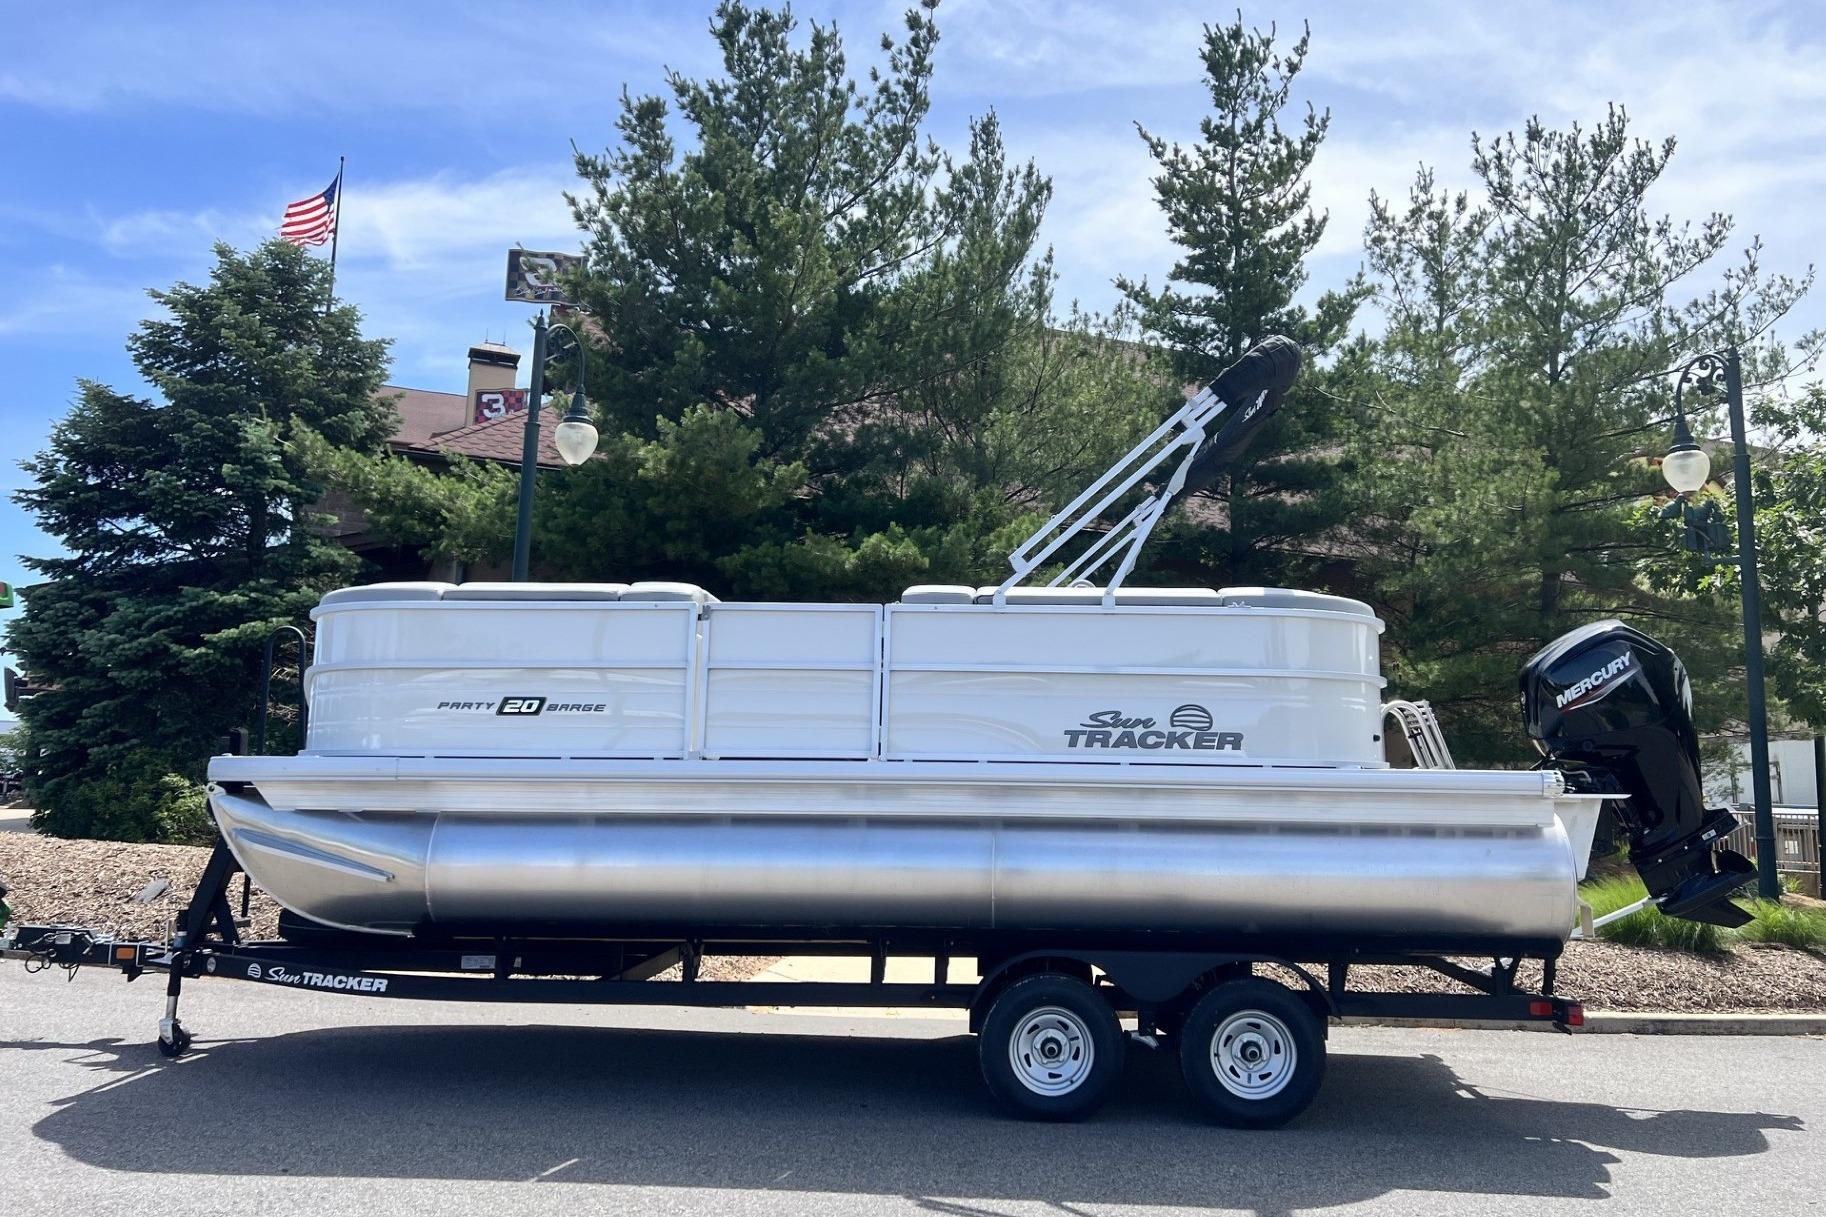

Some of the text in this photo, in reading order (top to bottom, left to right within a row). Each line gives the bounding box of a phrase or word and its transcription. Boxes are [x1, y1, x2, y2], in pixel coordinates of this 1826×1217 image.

[481, 393, 506, 419] 3
[1555, 650, 1631, 709] MERCURY
[436, 699, 607, 714] PARTY 20 BARGE
[1079, 710, 1157, 729] Sun
[1063, 729, 1244, 751] TRACKER
[264, 966, 389, 993] Sun TRACKER
